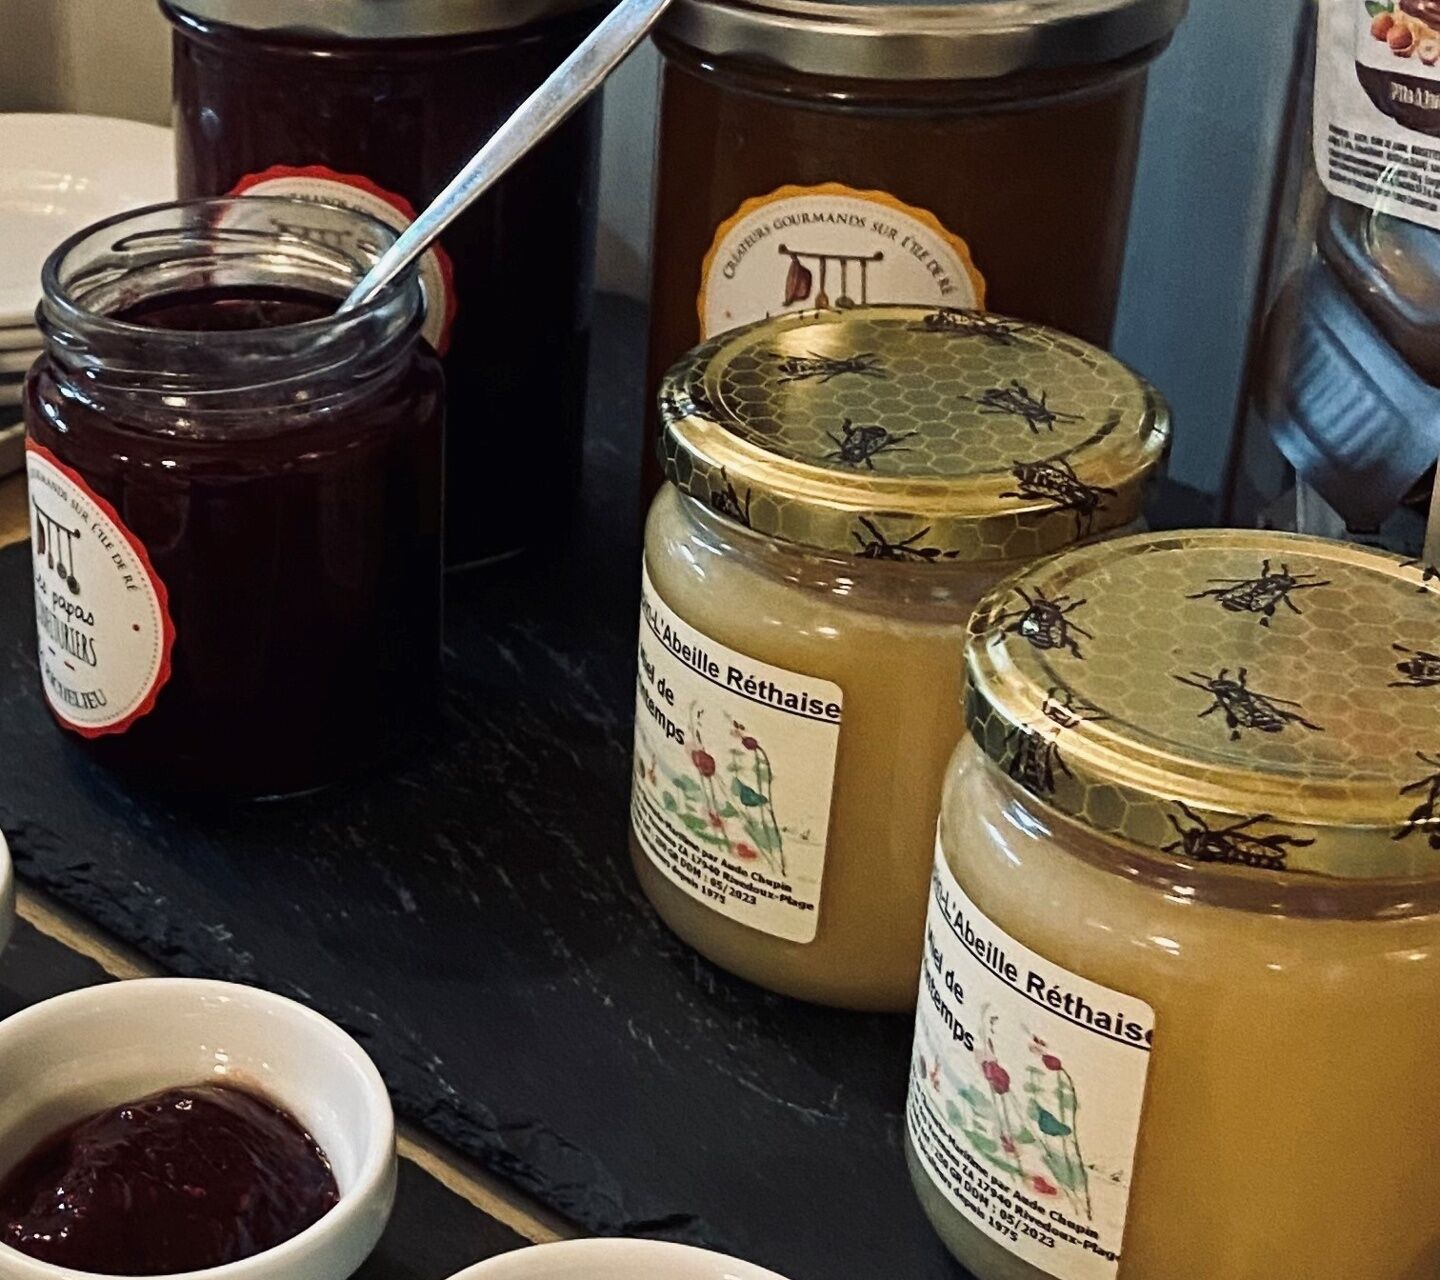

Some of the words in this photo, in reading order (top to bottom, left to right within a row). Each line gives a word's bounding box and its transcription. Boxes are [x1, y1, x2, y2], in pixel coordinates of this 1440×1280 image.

[773, 212, 866, 230] GOURMANDS
[872, 221, 898, 241] SUR
[52, 591, 95, 627] papas
[657, 677, 675, 707] de
[726, 665, 841, 719] Réthaise
[945, 970, 964, 1006] de
[976, 1178, 1013, 1209] 17940
[987, 1216, 1019, 1242] 1975
[999, 1209, 1056, 1249] 05/2023
[1048, 1209, 1100, 1241] Chupin
